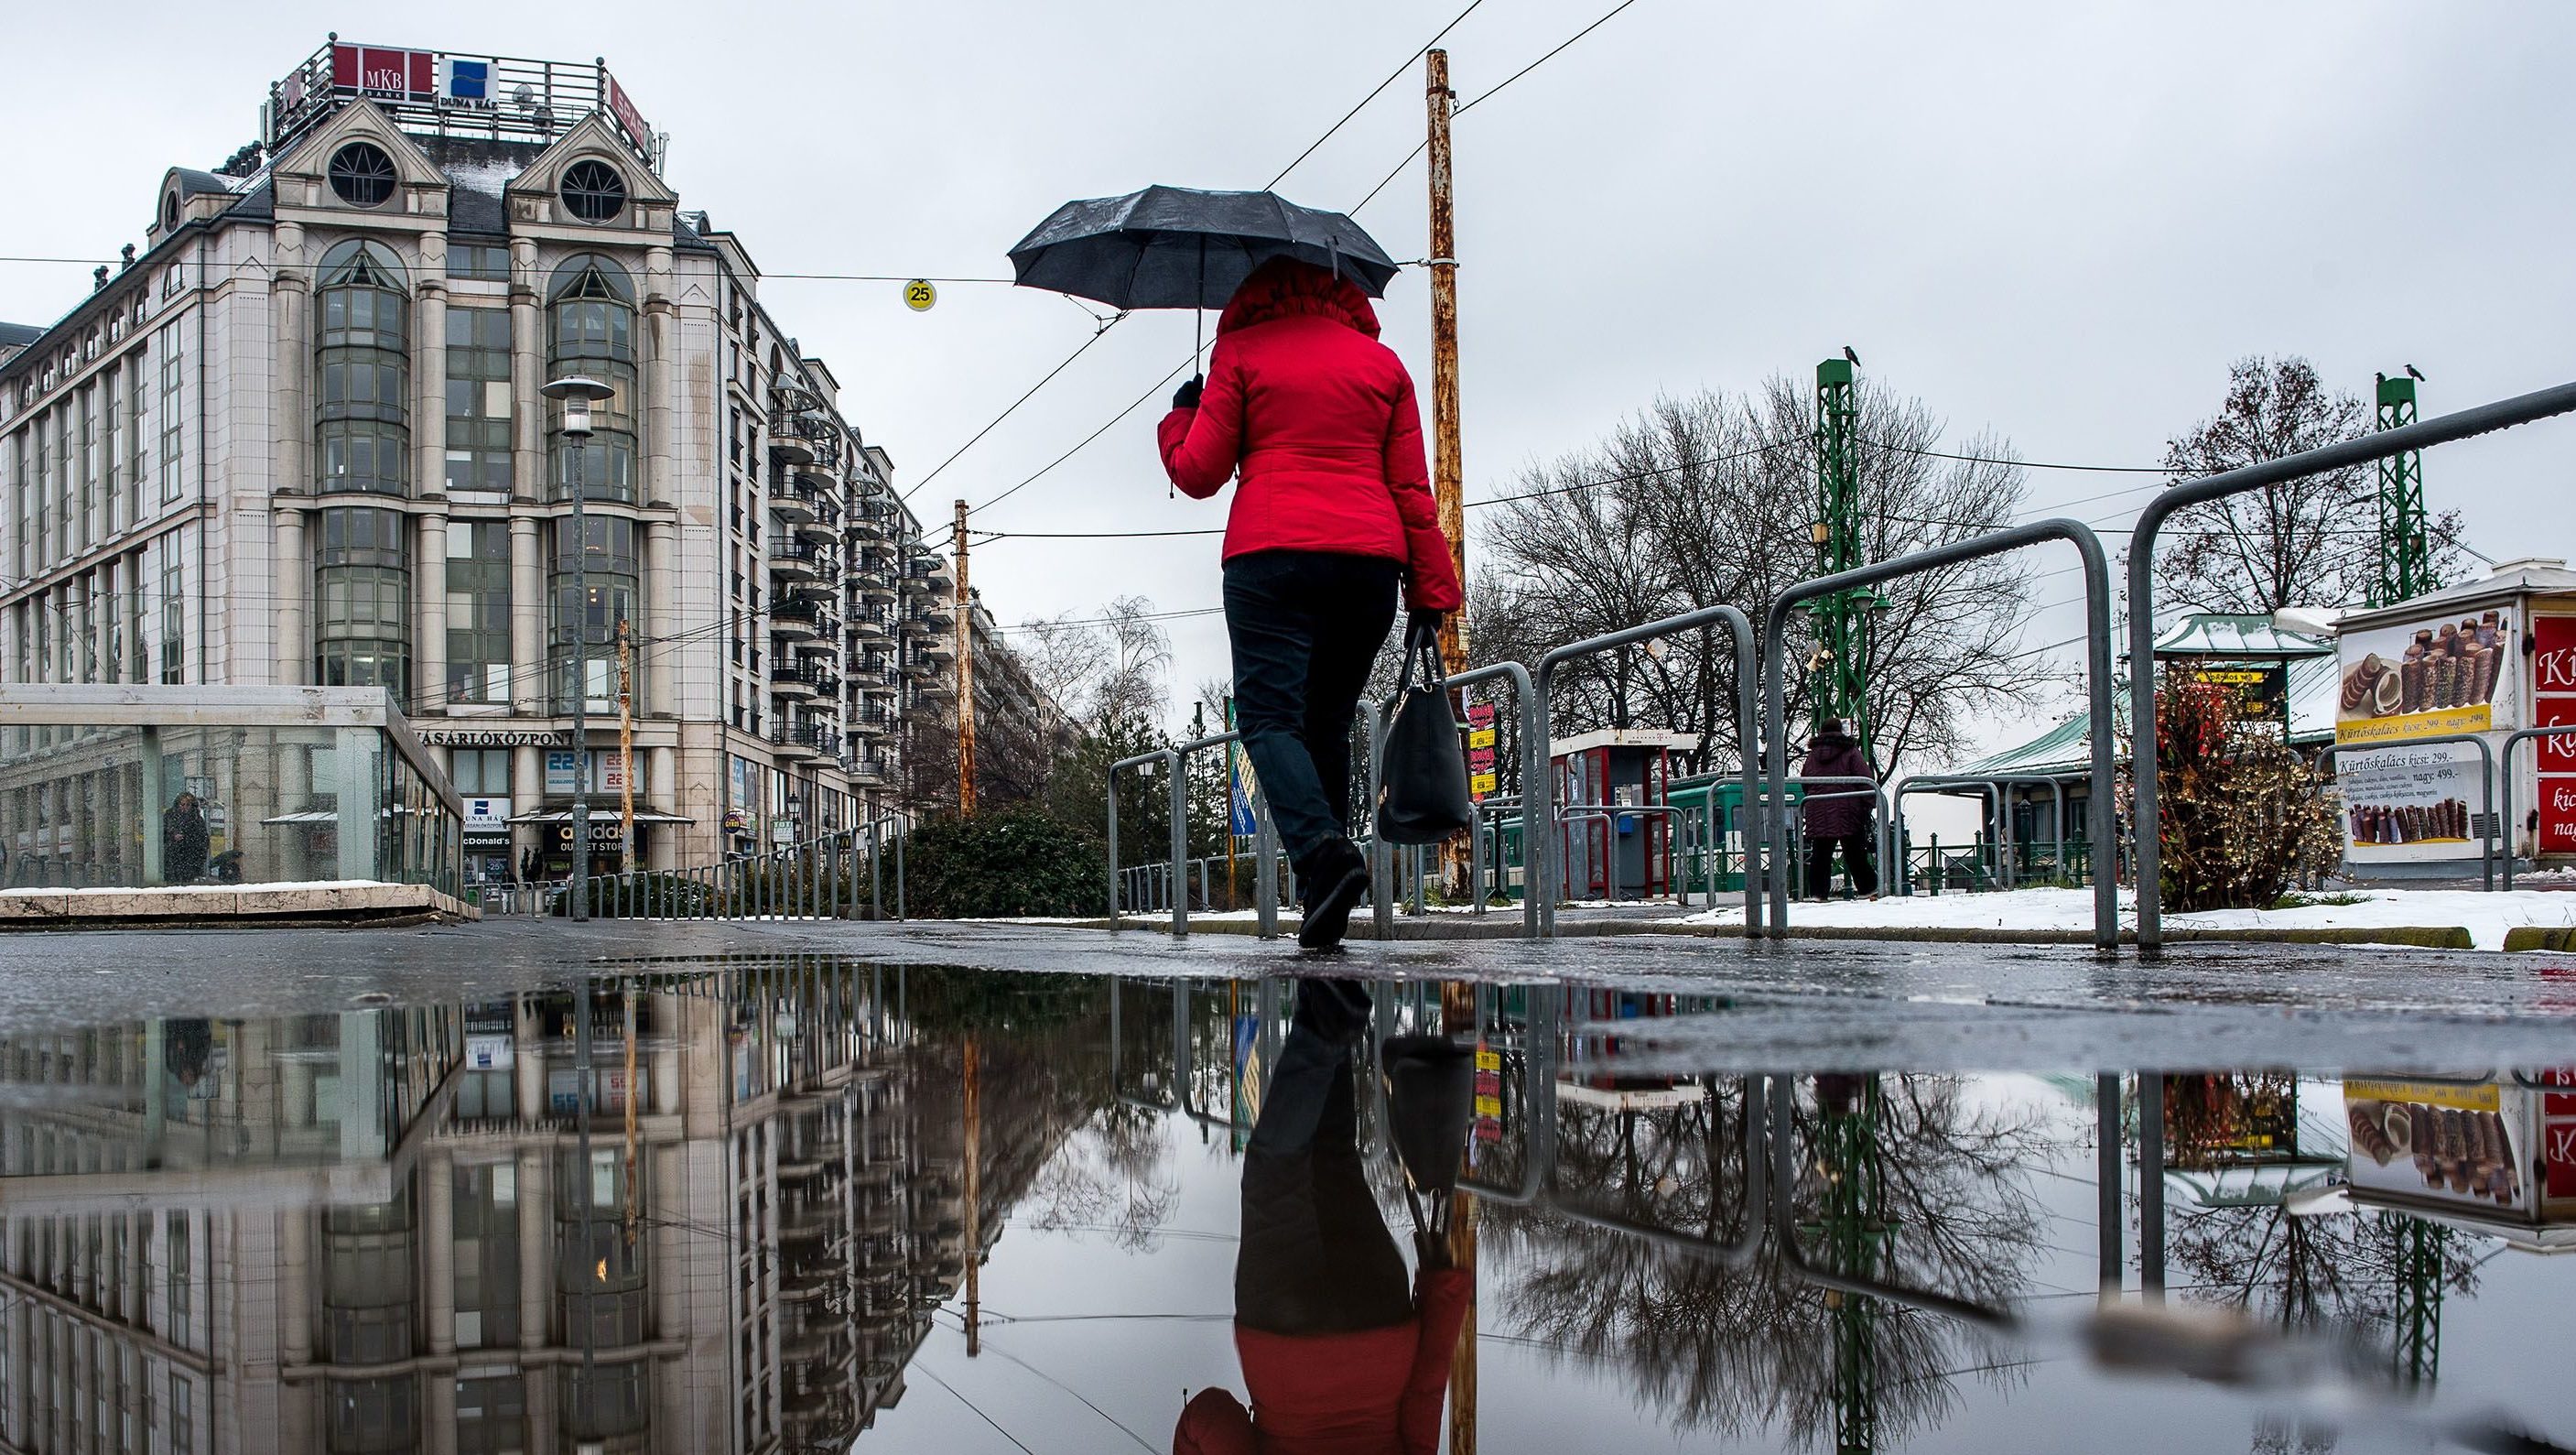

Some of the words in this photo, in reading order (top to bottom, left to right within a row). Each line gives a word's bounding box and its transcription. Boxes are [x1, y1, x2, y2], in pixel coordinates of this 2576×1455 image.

[367, 69, 402, 90] MKB
[440, 97, 472, 109] DUNA
[475, 98, 498, 110] HÁZ
[617, 92, 644, 147] SPAR
[911, 288, 930, 301] 25
[417, 730, 574, 746] ÁSÁRLÓKÖZPONT
[2339, 722, 2399, 741] Kürtőskalács
[2339, 755, 2406, 773] Kürtőskalács
[2408, 753, 2430, 767] kicsi:
[2431, 752, 2453, 764] 299.-
[2413, 772, 2435, 785] nagy:
[2437, 768, 2459, 780] 499.-
[463, 837, 510, 845] cDonald's
[599, 842, 623, 852] STOR
